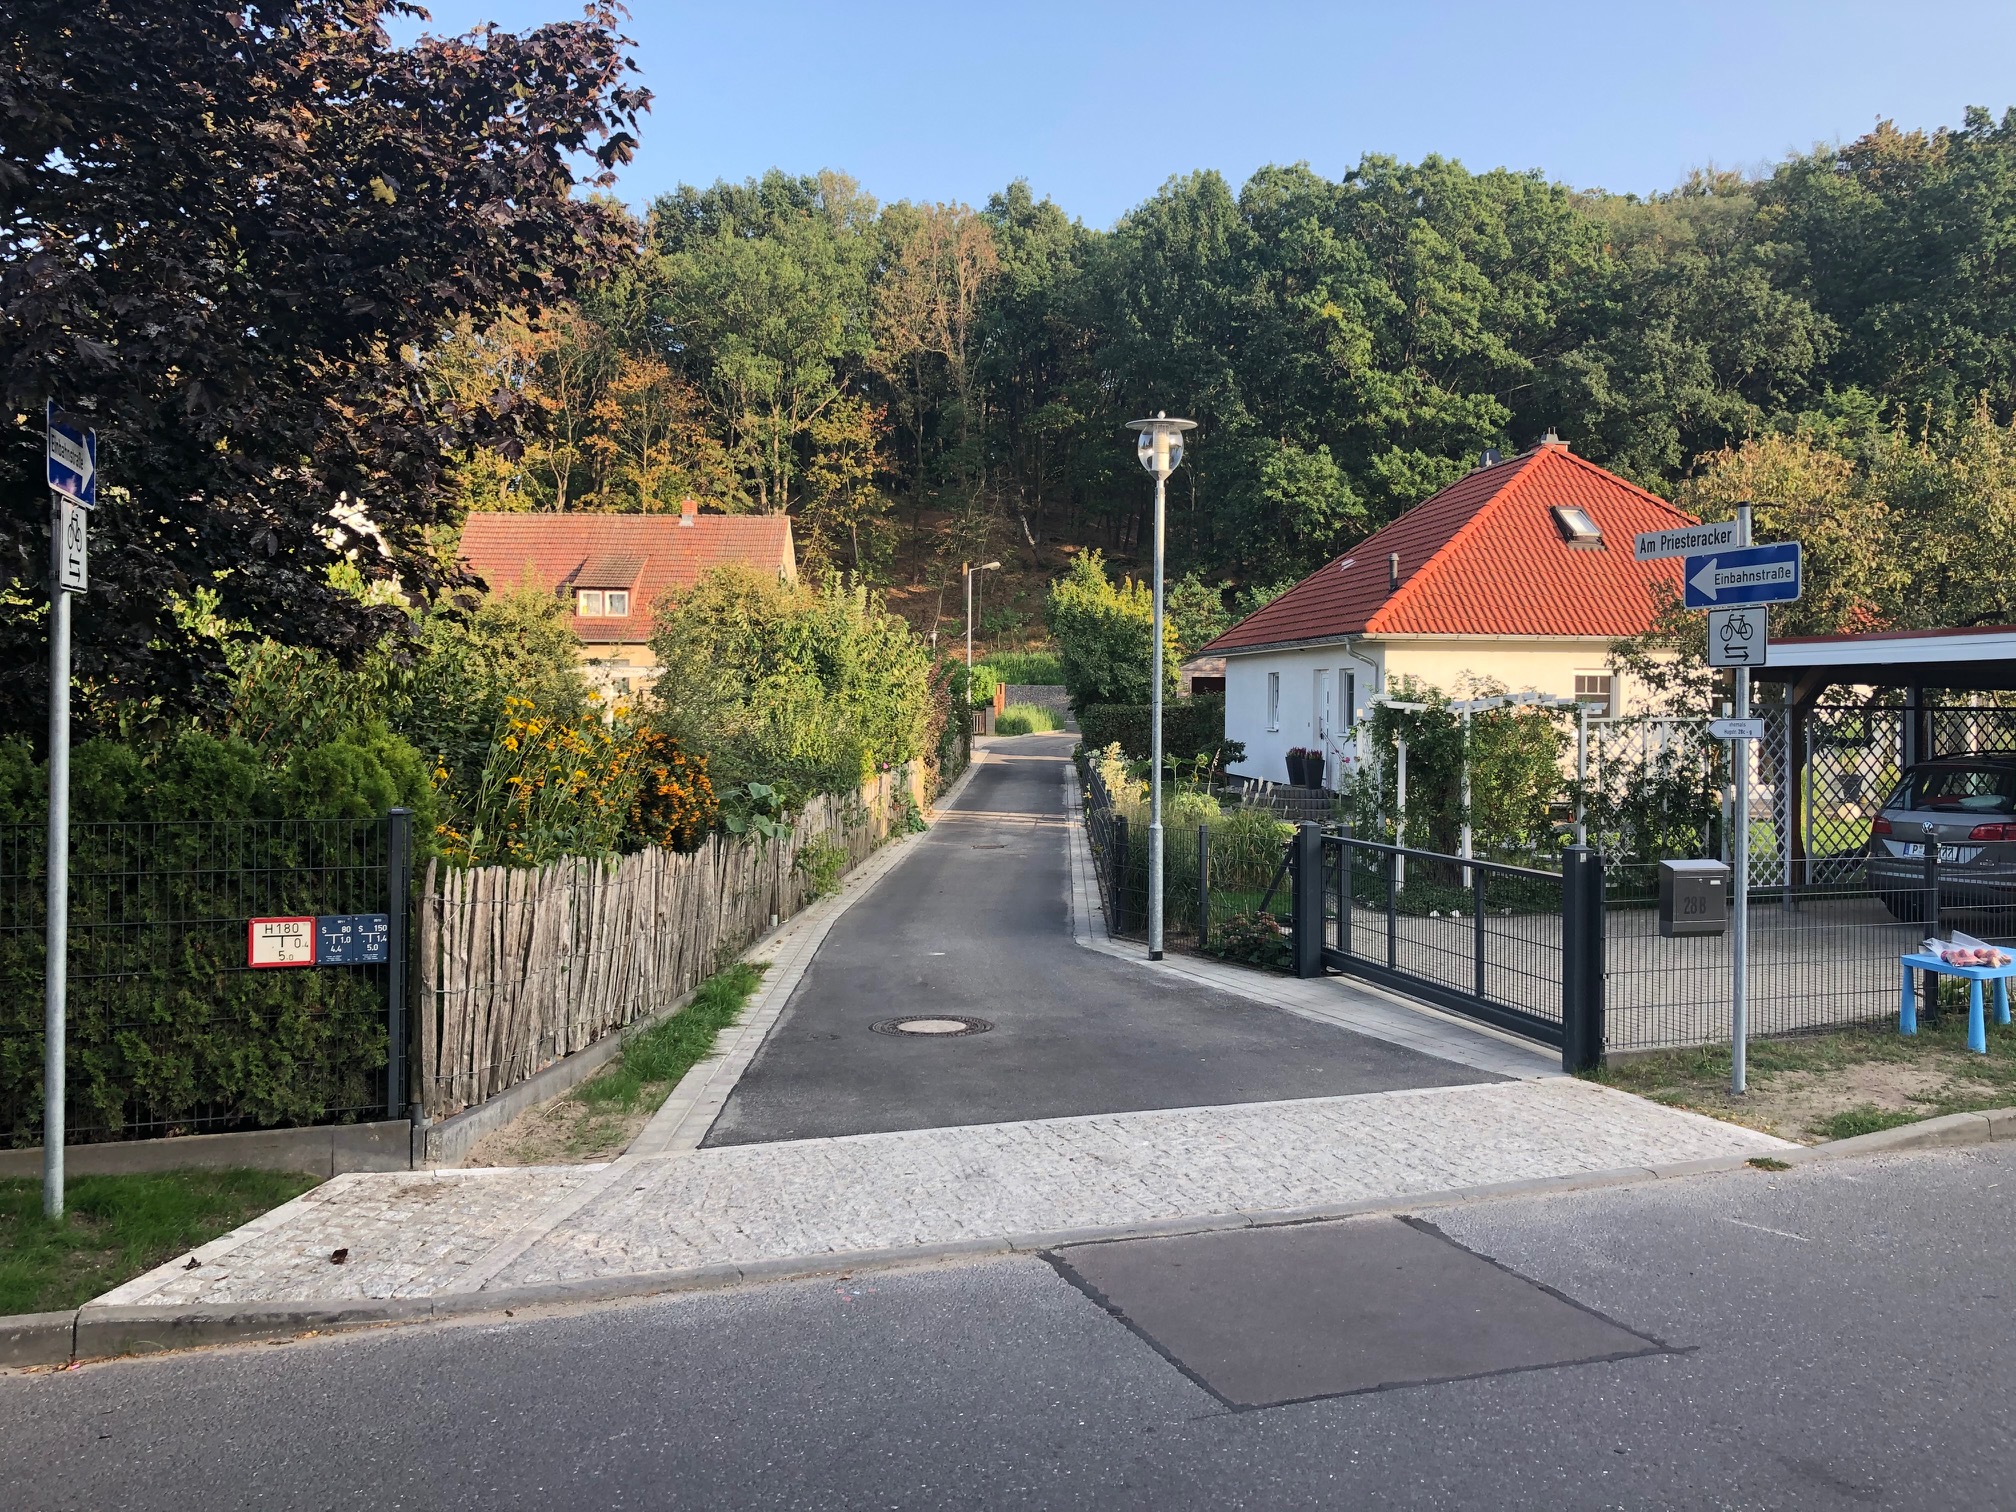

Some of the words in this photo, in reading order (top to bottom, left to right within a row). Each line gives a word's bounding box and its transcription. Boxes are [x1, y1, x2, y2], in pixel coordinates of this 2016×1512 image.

[1639, 538, 1656, 554] Am
[1660, 528, 1732, 551] Priesteracker
[1714, 566, 1791, 586] Einbahnstraße
[321, 926, 327, 934] S
[341, 925, 351, 933] 80
[373, 924, 387, 932] 150
